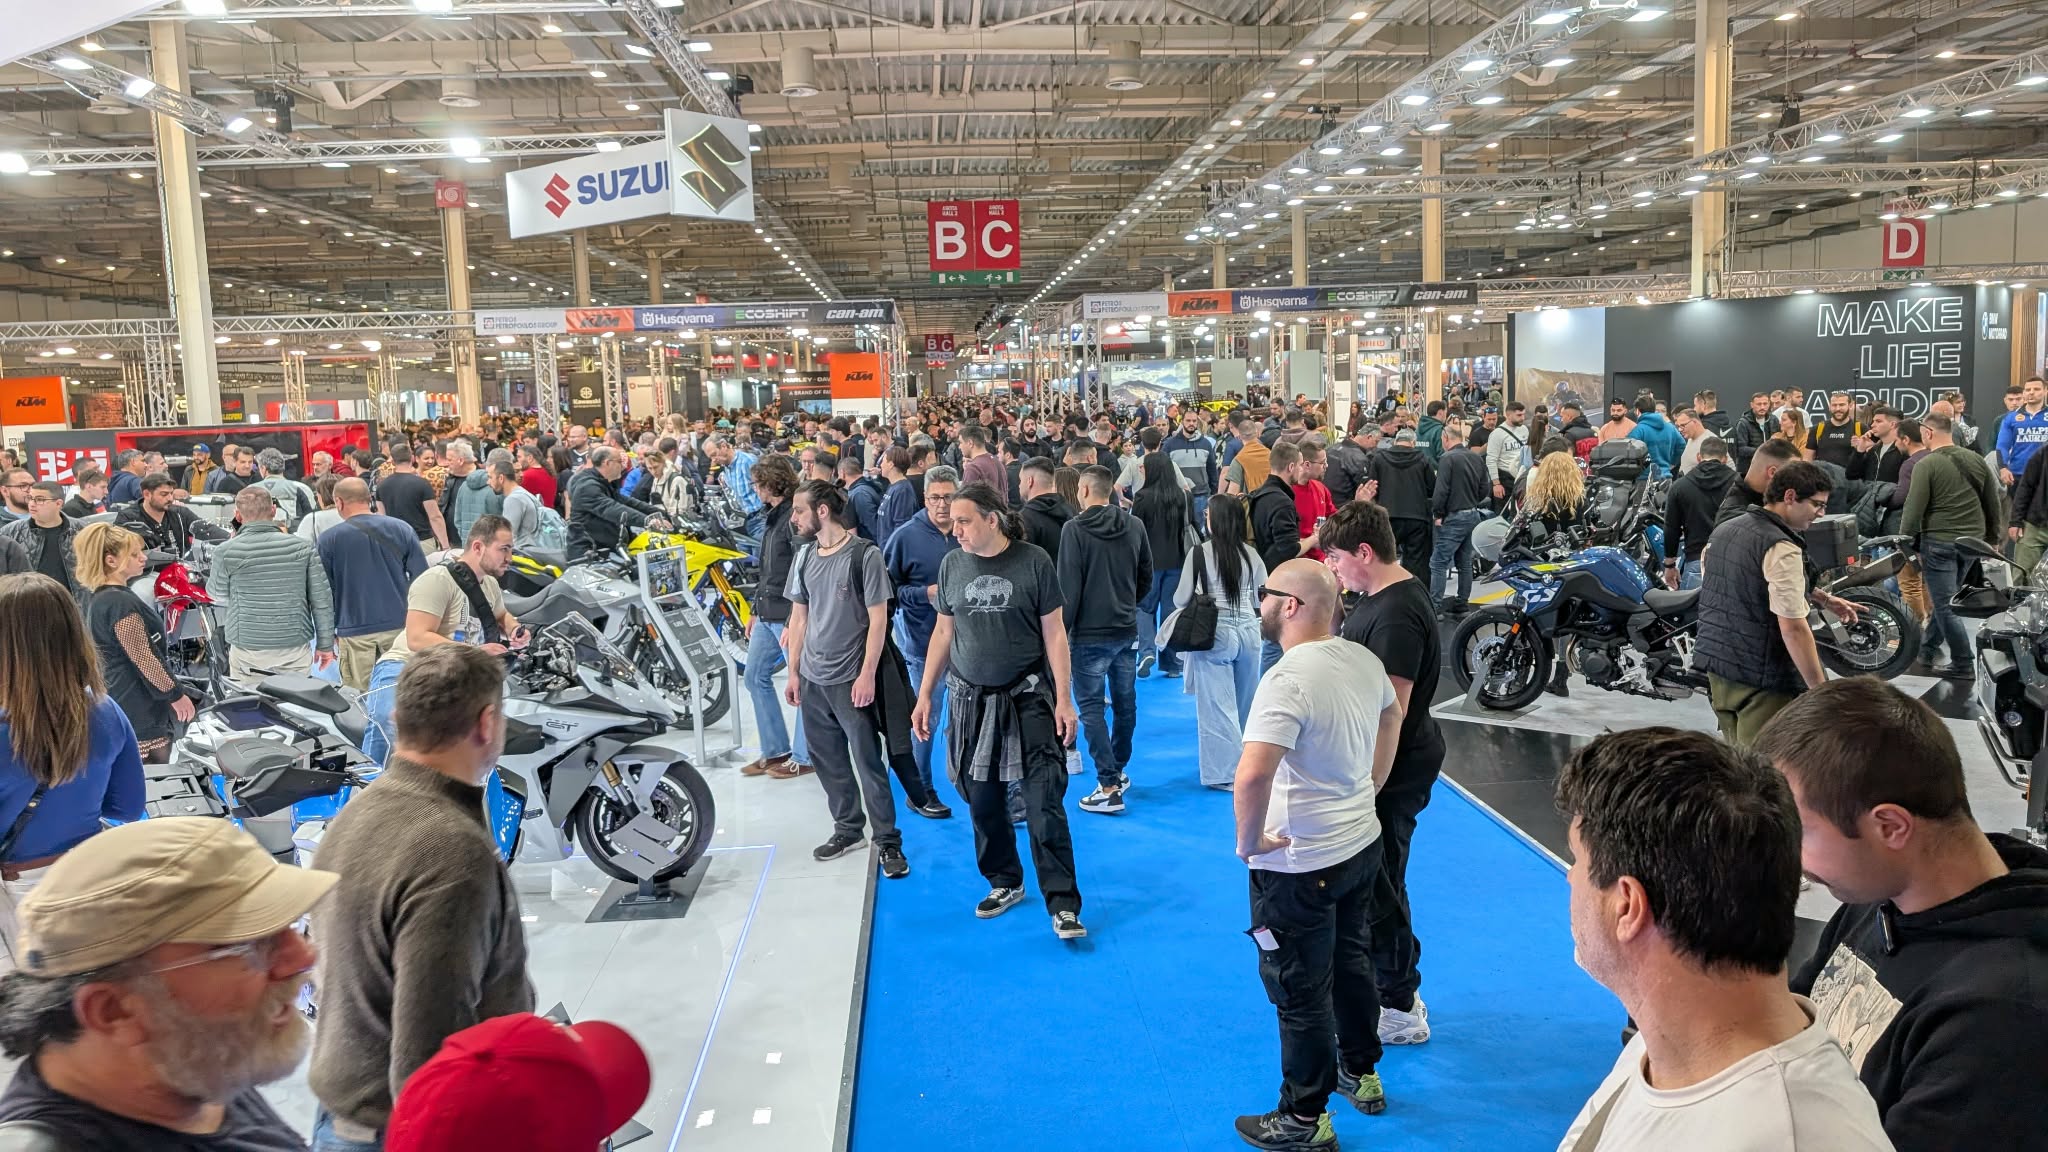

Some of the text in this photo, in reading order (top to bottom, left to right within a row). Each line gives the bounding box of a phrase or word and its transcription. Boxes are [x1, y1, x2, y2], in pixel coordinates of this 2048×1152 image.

[935, 220, 967, 260] B
[981, 219, 1014, 259] C
[1888, 222, 1919, 260] D
[1413, 289, 1469, 301] can-am
[1181, 297, 1219, 311] KTM
[1251, 296, 1308, 308] Husqvarna
[655, 313, 715, 326] Husqvarna
[826, 308, 884, 320] can-am
[1817, 296, 1963, 338] MAKE
[580, 314, 619, 328] KTM
[927, 339, 938, 350] B
[941, 340, 952, 352] C
[1860, 341, 1962, 379] LIFE
[845, 370, 874, 381] KTM
[15, 396, 47, 408] KTM
[38, 451, 108, 482] ヨシラ
